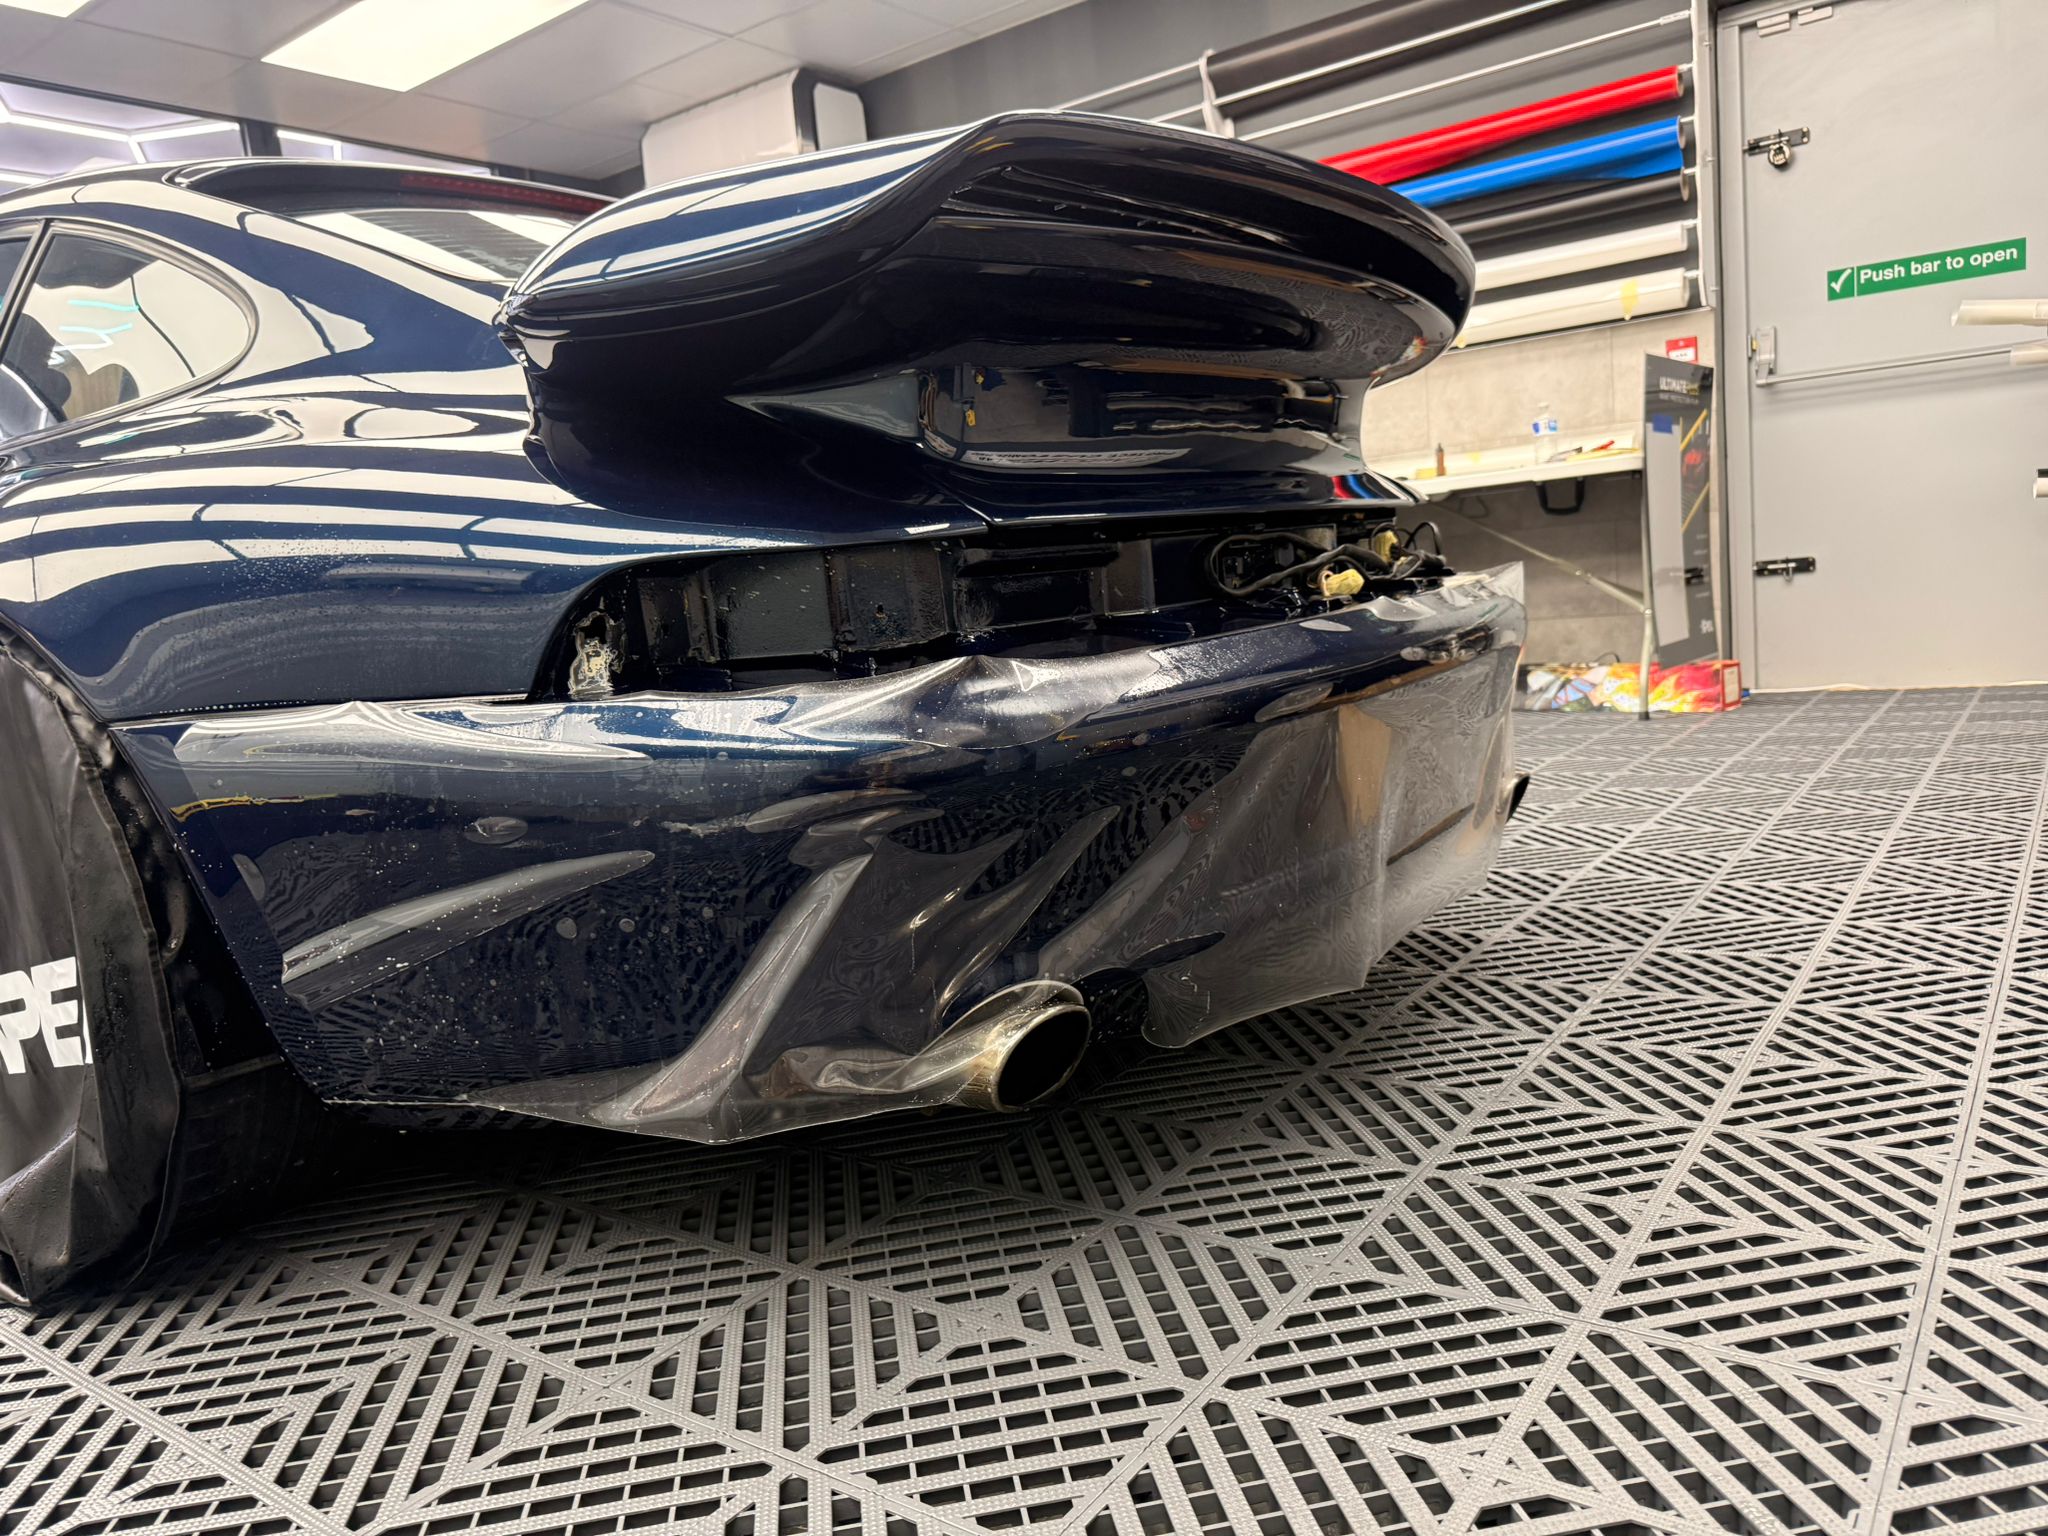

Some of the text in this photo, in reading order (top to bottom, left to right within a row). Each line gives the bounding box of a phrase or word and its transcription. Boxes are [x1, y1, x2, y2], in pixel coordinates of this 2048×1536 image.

[1860, 247, 2018, 284] Push bar to open
[0, 957, 93, 1075] PE
